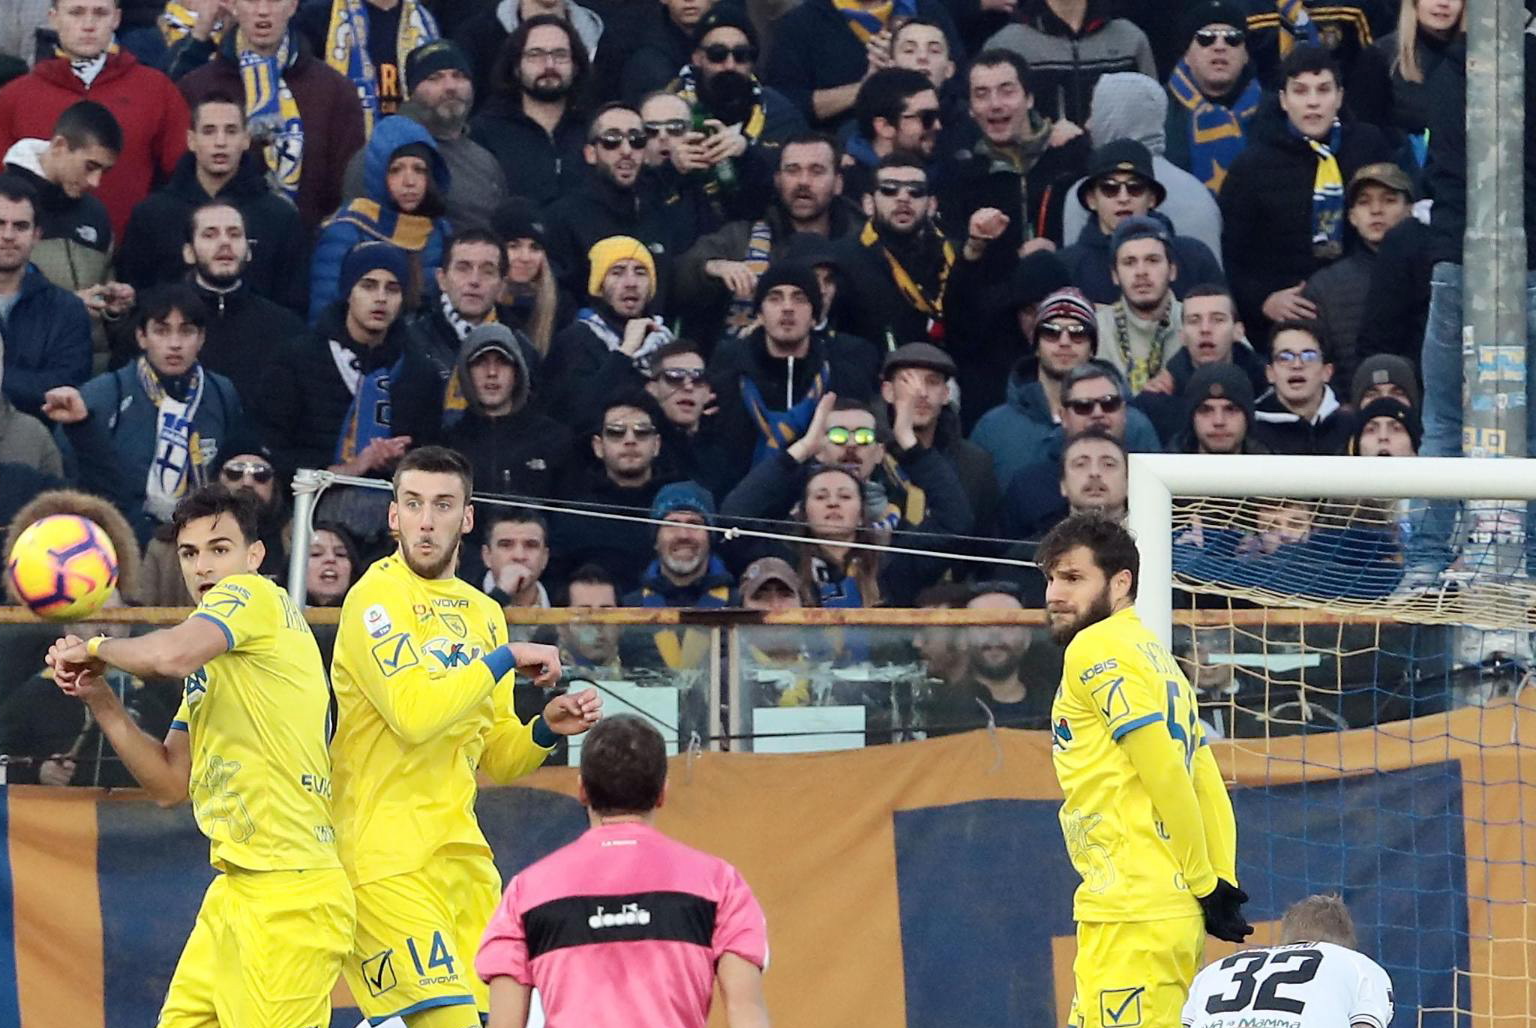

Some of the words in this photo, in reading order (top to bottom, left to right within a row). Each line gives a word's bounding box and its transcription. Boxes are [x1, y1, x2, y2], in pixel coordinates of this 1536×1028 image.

[1079, 658, 1119, 683] NOBIS
[406, 930, 454, 977] 14
[419, 974, 459, 986] GIVOVA
[1205, 950, 1324, 1015] 32
